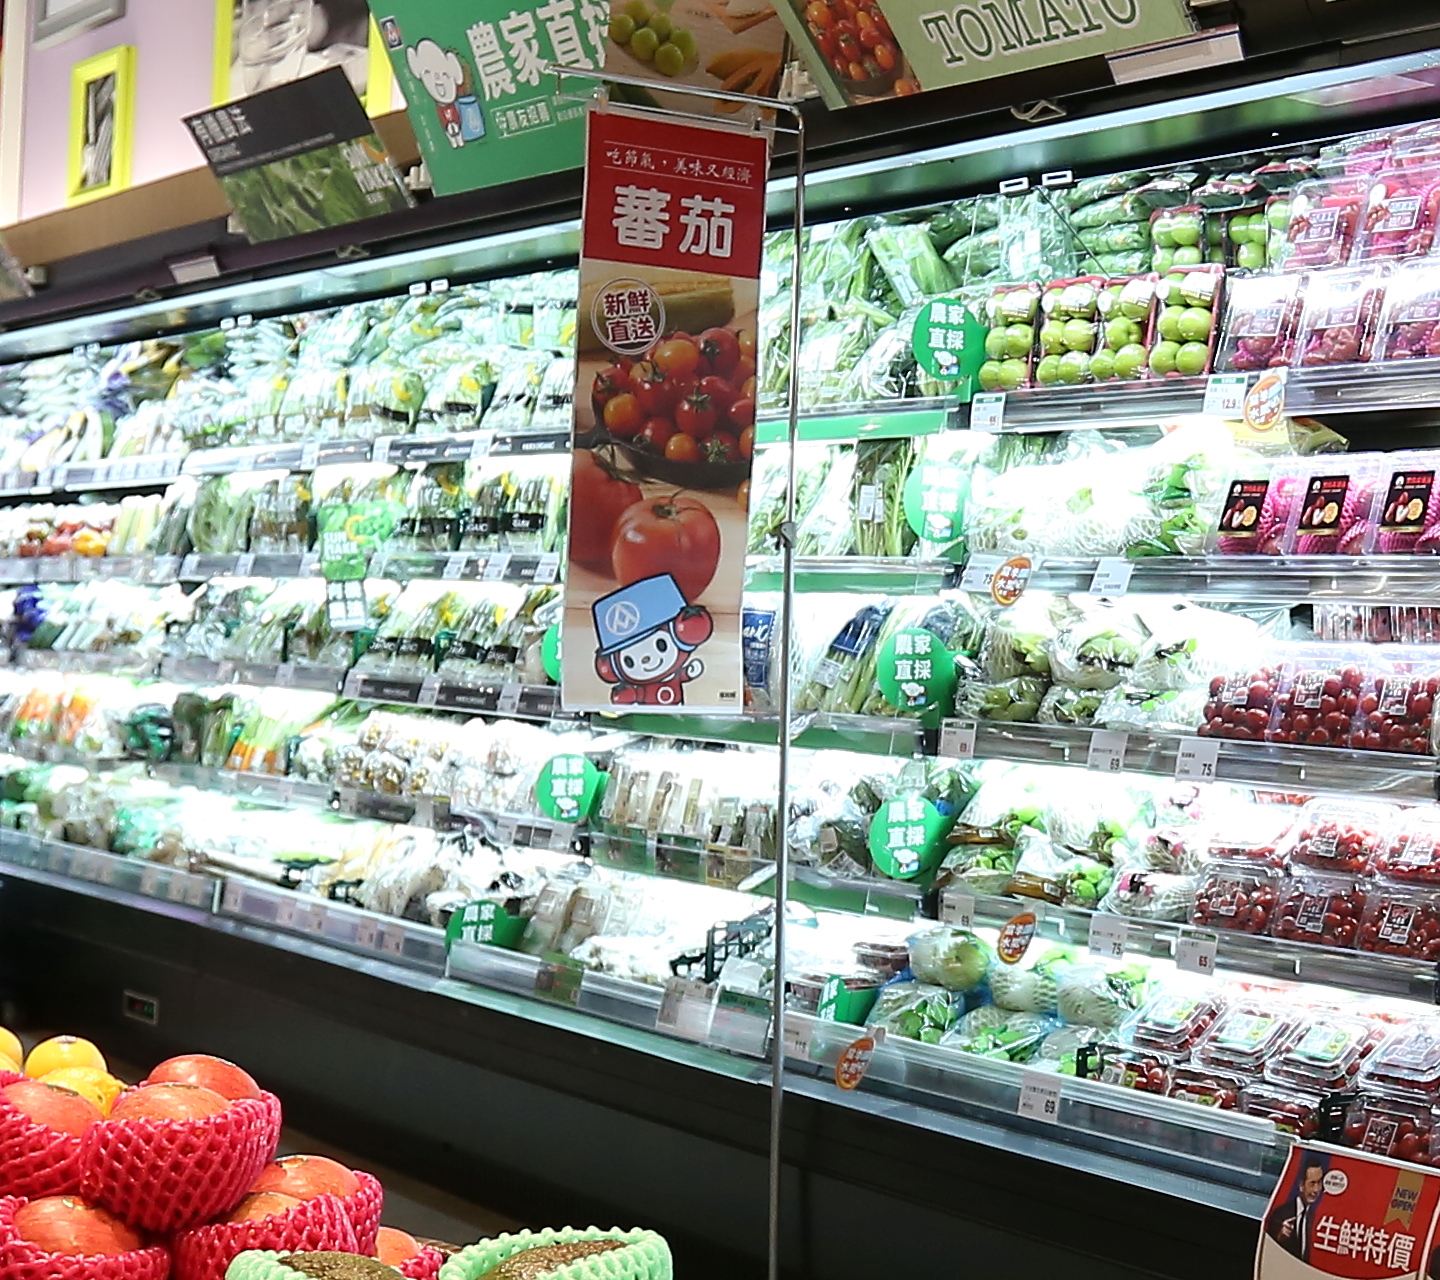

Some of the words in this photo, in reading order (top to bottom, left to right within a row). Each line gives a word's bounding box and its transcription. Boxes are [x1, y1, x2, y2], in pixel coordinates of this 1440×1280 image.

[611, 184, 735, 259] 蕃茄
[604, 289, 650, 318] 新鮮
[928, 301, 966, 325] 農家
[607, 316, 656, 344] 直送
[927, 327, 965, 351] 直採
[893, 633, 933, 657] 農家
[893, 659, 933, 682] 直採
[550, 754, 586, 776] 農家
[549, 776, 585, 799] 直採
[887, 800, 926, 824] 農家
[887, 825, 926, 848] 直採
[1389, 1196, 1417, 1213] OPEN
[1395, 1186, 1420, 1203] NEW
[1313, 1216, 1416, 1274] 生鮮特價
